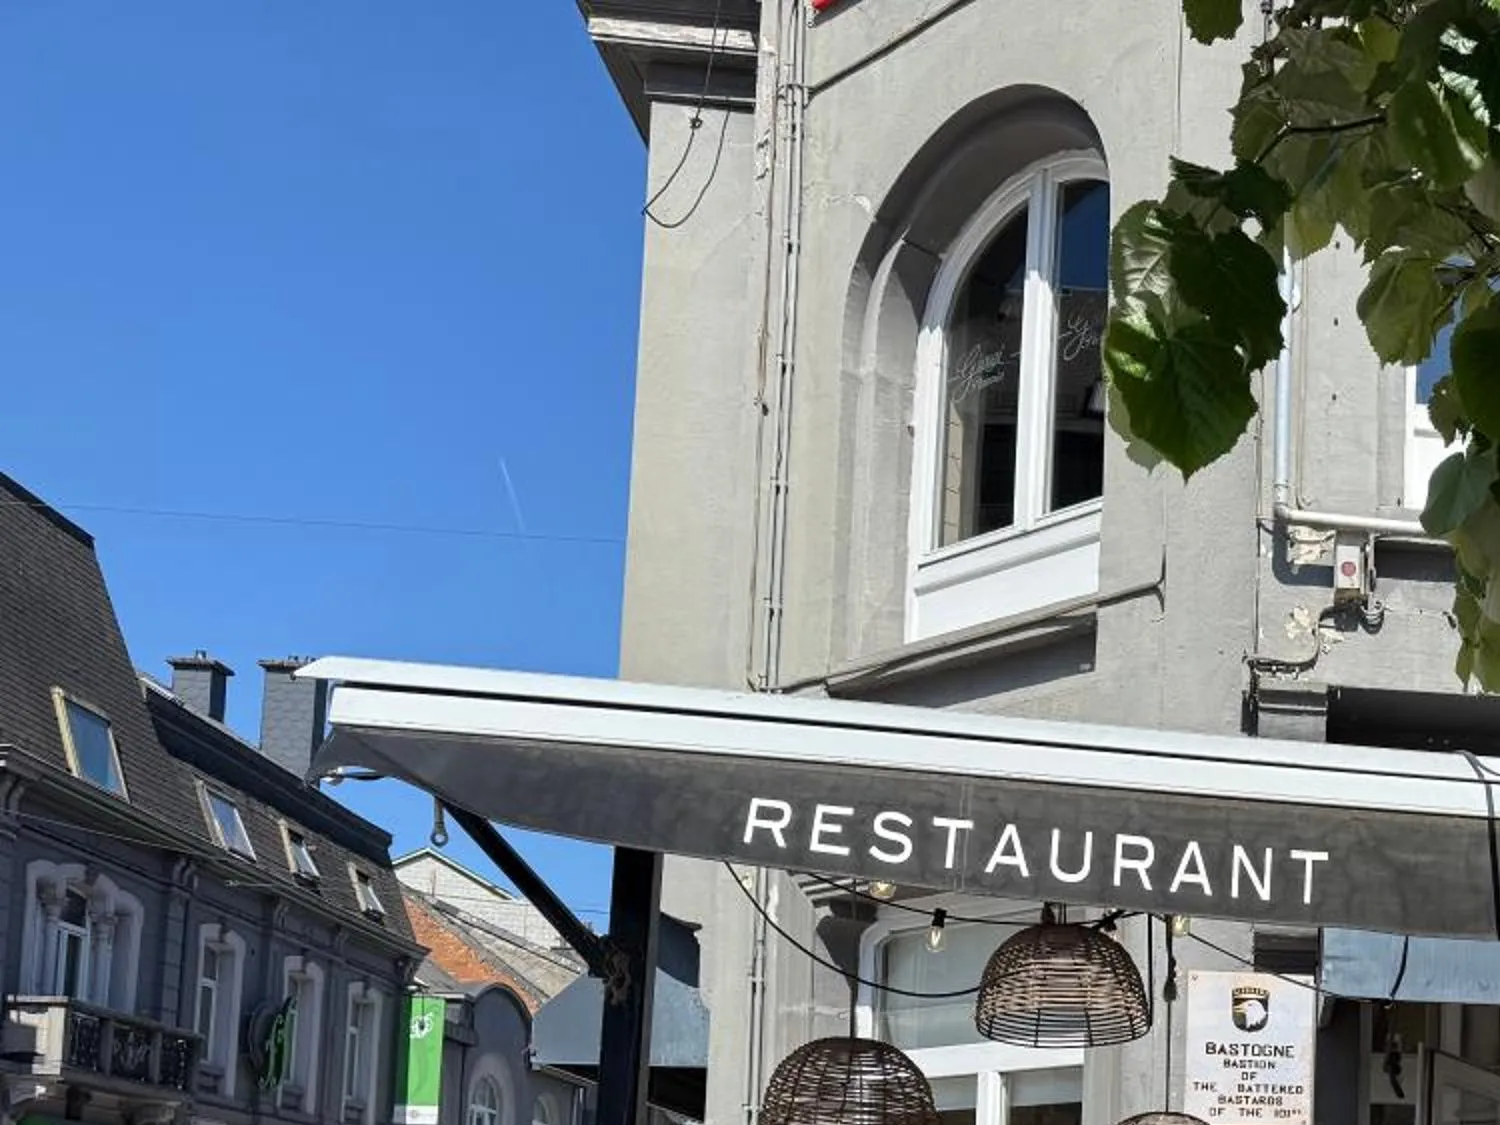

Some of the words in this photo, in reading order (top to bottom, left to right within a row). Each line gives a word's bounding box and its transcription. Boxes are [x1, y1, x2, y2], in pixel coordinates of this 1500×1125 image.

[742, 796, 1329, 906] RESTAURANT
[1205, 1041, 1295, 1058] BASTOGNE
[1223, 1059, 1276, 1069] BASTION
[1241, 1071, 1258, 1081] OF
[1193, 1081, 1218, 1092] THE
[1237, 1083, 1304, 1095] BATTERED
[1217, 1094, 1284, 1106] BASTARDS
[1209, 1107, 1226, 1117] OF
[1238, 1107, 1263, 1118] THE
